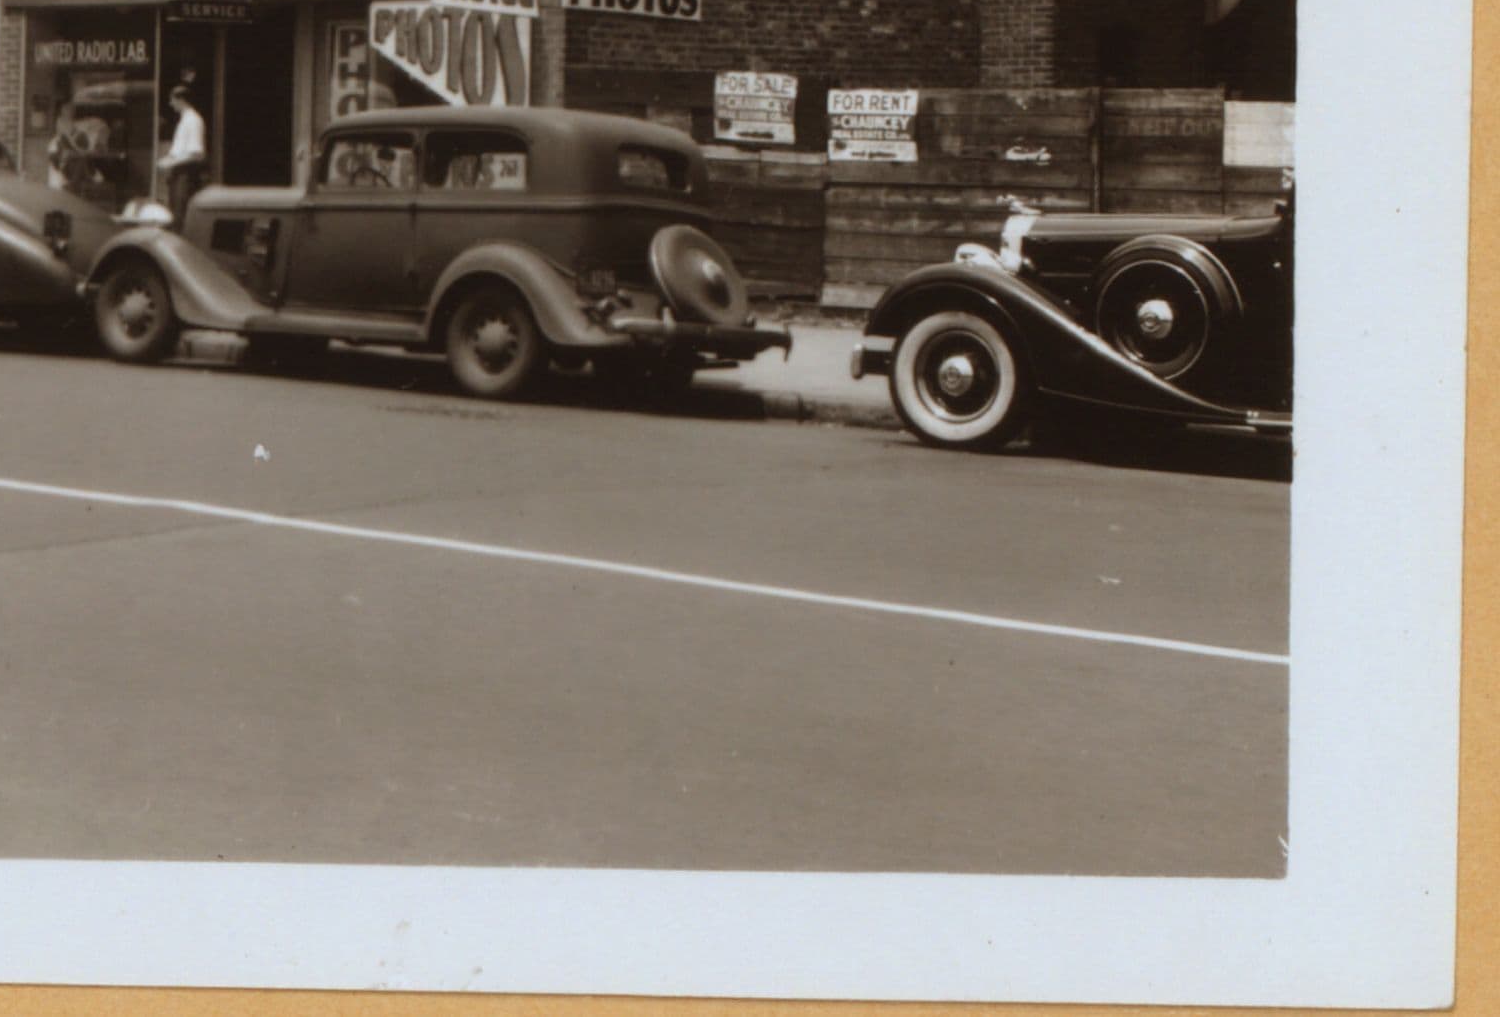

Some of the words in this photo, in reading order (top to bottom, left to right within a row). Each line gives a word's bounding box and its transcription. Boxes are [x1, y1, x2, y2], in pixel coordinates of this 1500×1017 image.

[181, 3, 246, 18] SERVICE
[34, 41, 74, 64] UNITED
[77, 41, 117, 62] RADIO
[721, 75, 748, 92] FOR
[754, 76, 792, 95] SALE
[834, 94, 864, 111] FOR
[869, 94, 911, 111] RENT
